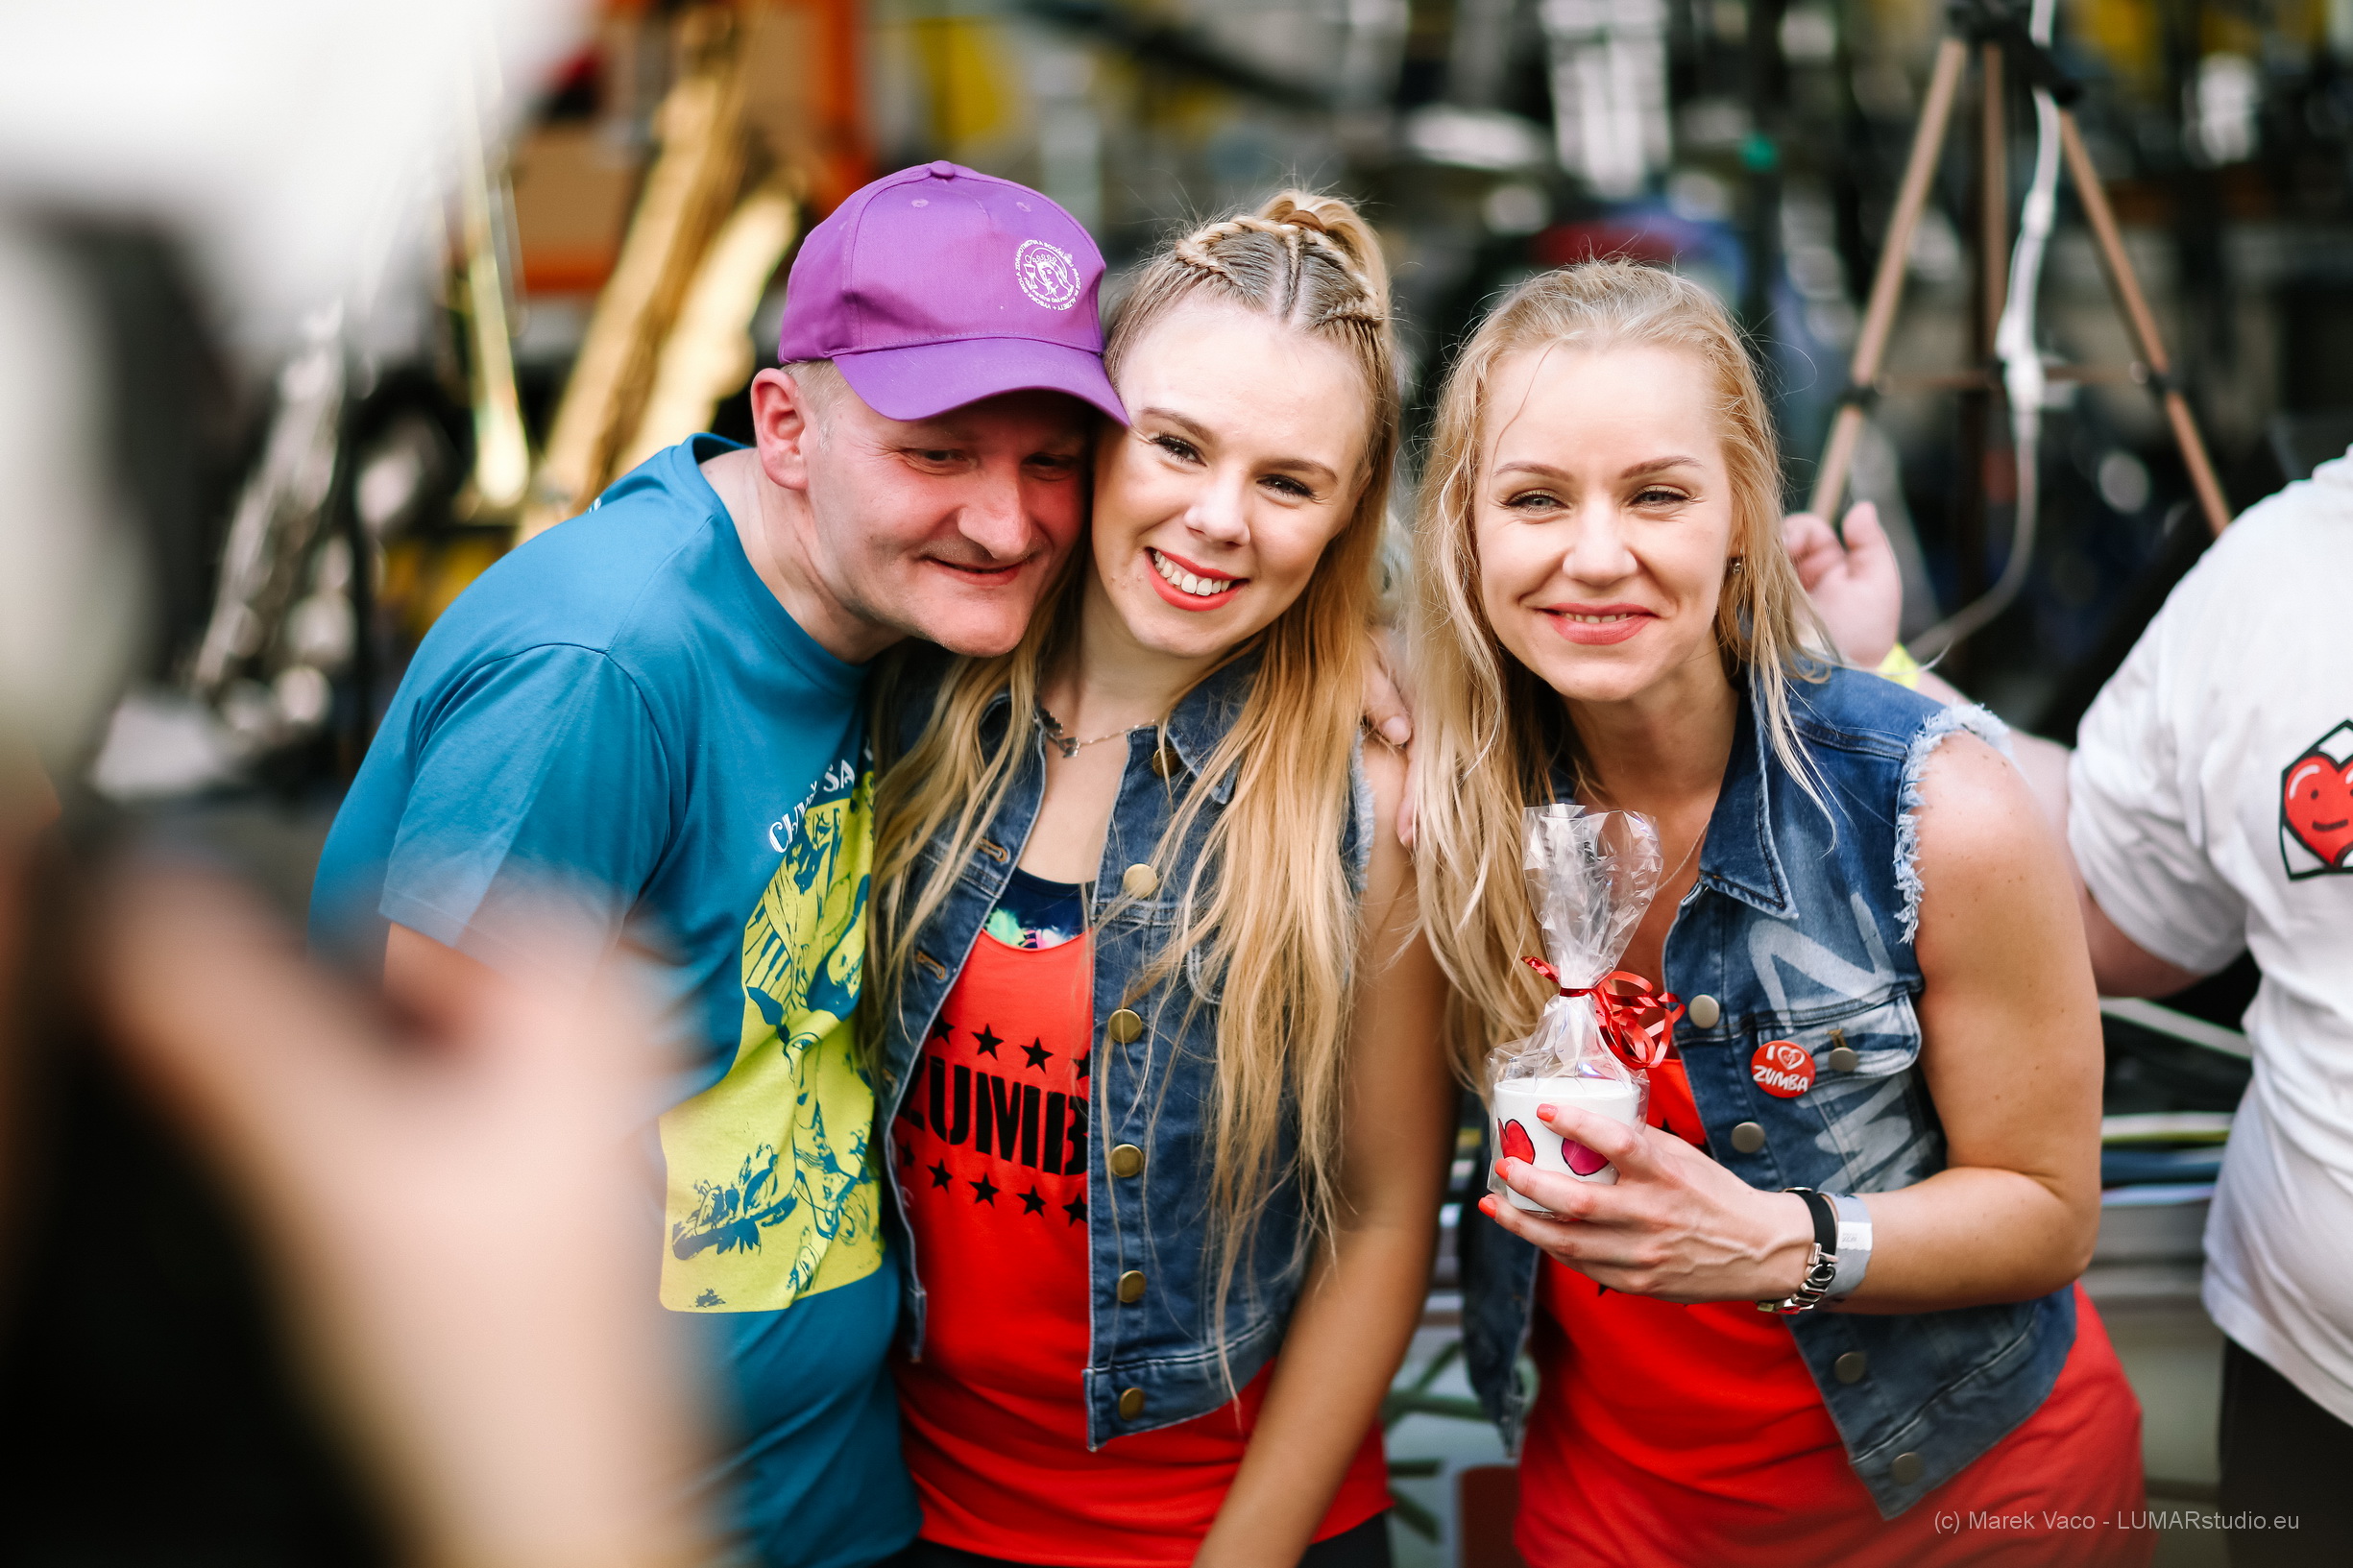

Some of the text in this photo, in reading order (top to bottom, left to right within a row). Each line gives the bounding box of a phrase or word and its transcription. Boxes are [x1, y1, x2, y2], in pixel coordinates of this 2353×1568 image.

[1766, 1045, 1777, 1060] I
[1753, 1065, 1809, 1092] ZUMBA
[896, 1052, 1090, 1176] ZUMB
